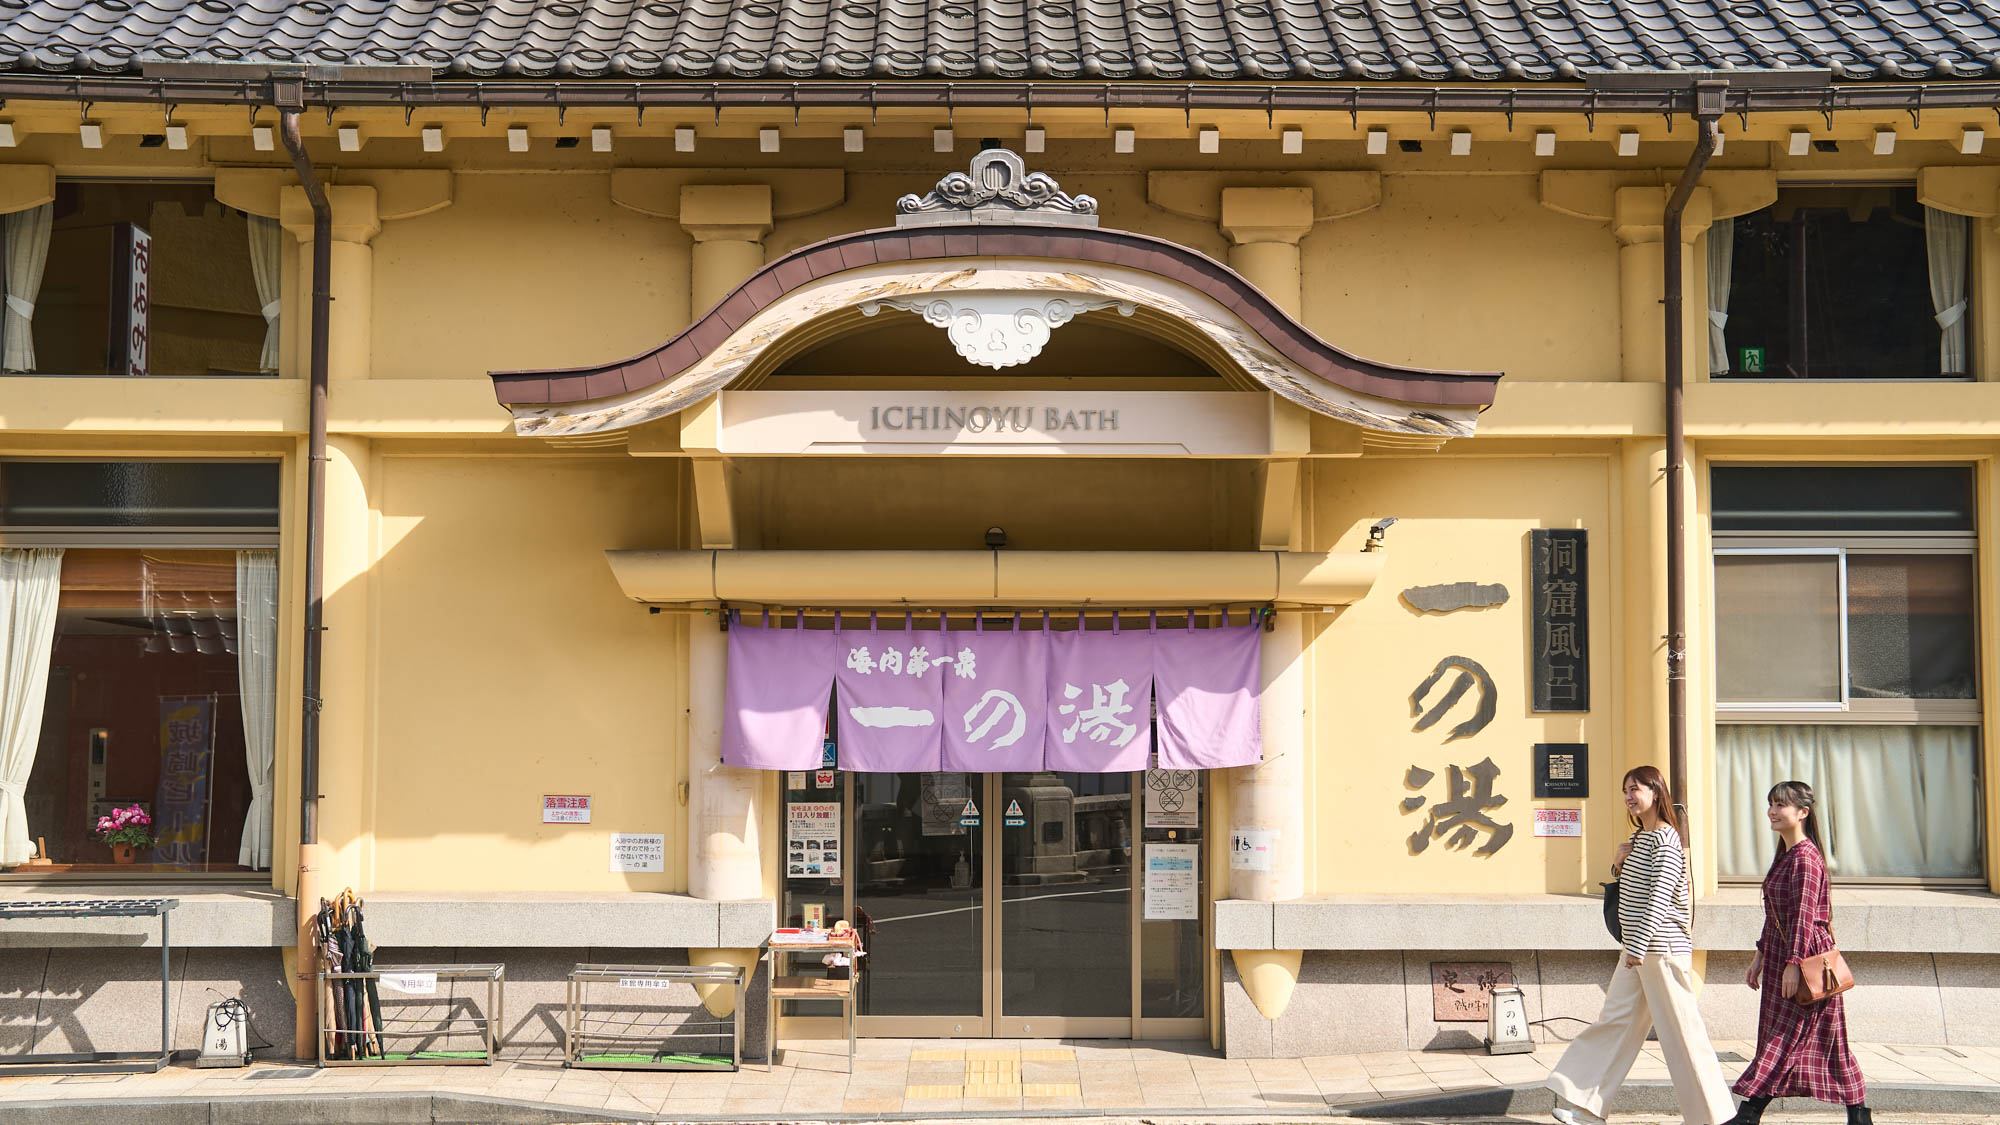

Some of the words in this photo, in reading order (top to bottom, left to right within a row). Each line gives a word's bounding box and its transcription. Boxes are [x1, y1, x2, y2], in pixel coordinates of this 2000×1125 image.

[870, 405, 1035, 432] ICHINOYU
[1045, 407, 1120, 431] BATH
[1541, 537, 1581, 702] 洞窟風呂
[846, 646, 978, 679] 海内第一泉
[849, 679, 1138, 751] 一の湯
[1401, 581, 1514, 860] 一の湯
[546, 797, 588, 809] 落雪注意
[1536, 811, 1579, 822] 落雪注意
[1503, 999, 1518, 1038] 一の湯
